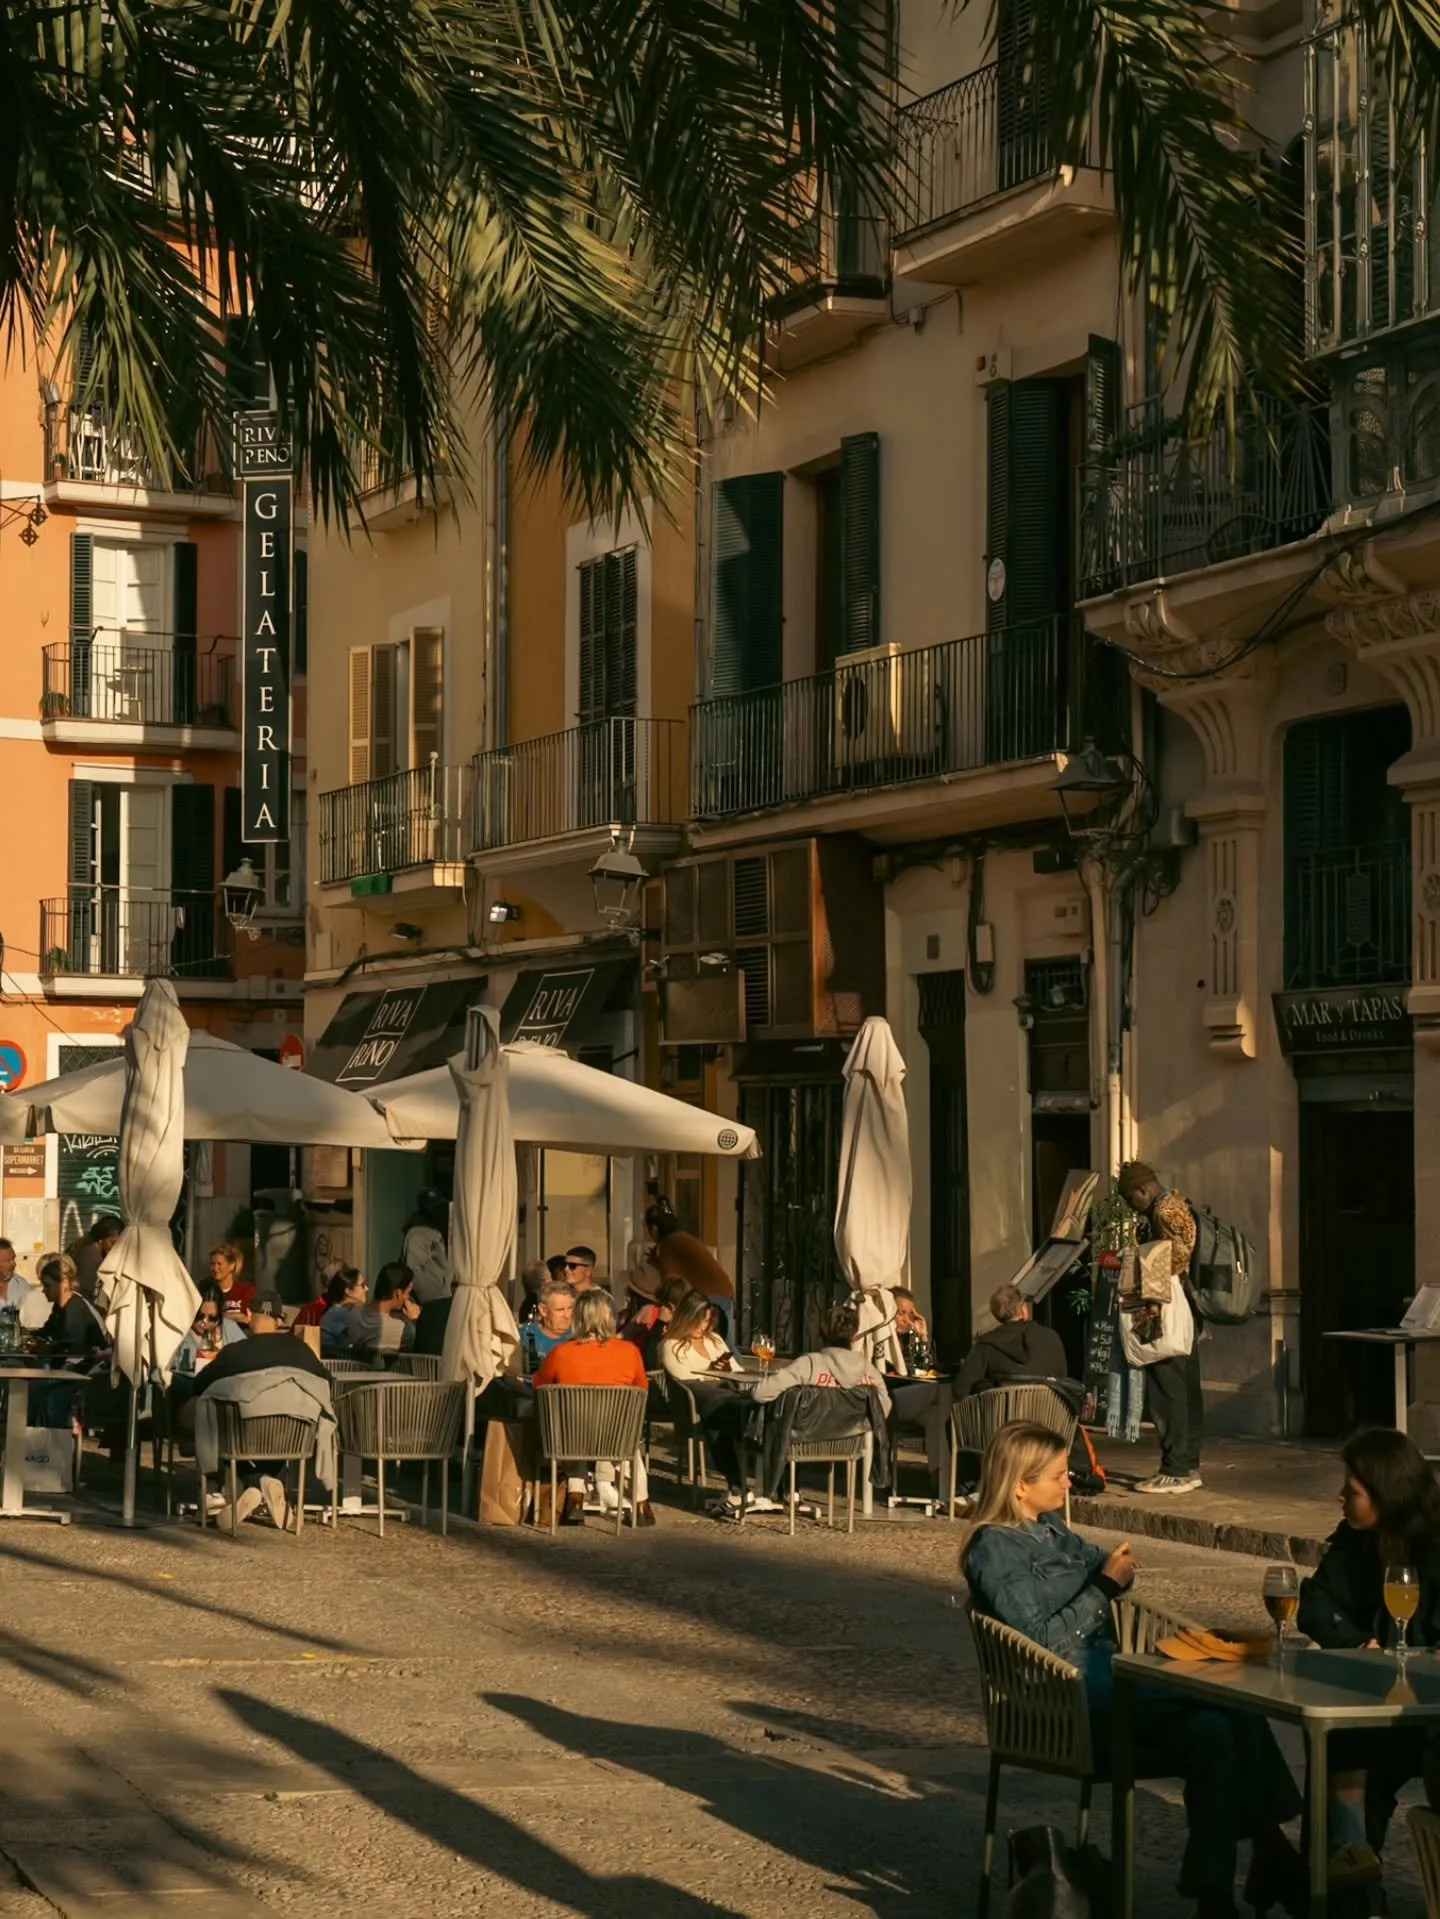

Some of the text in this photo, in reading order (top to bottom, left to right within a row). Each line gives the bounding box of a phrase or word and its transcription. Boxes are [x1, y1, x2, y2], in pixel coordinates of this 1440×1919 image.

[244, 426, 287, 443] RIV
[253, 492, 280, 829] GELATERIA
[371, 999, 413, 1031] RIVA
[527, 986, 579, 1021] RIVA
[1291, 1000, 1333, 1026] MAR
[1346, 995, 1403, 1023] TAPAS
[348, 1039, 395, 1069] RENO
